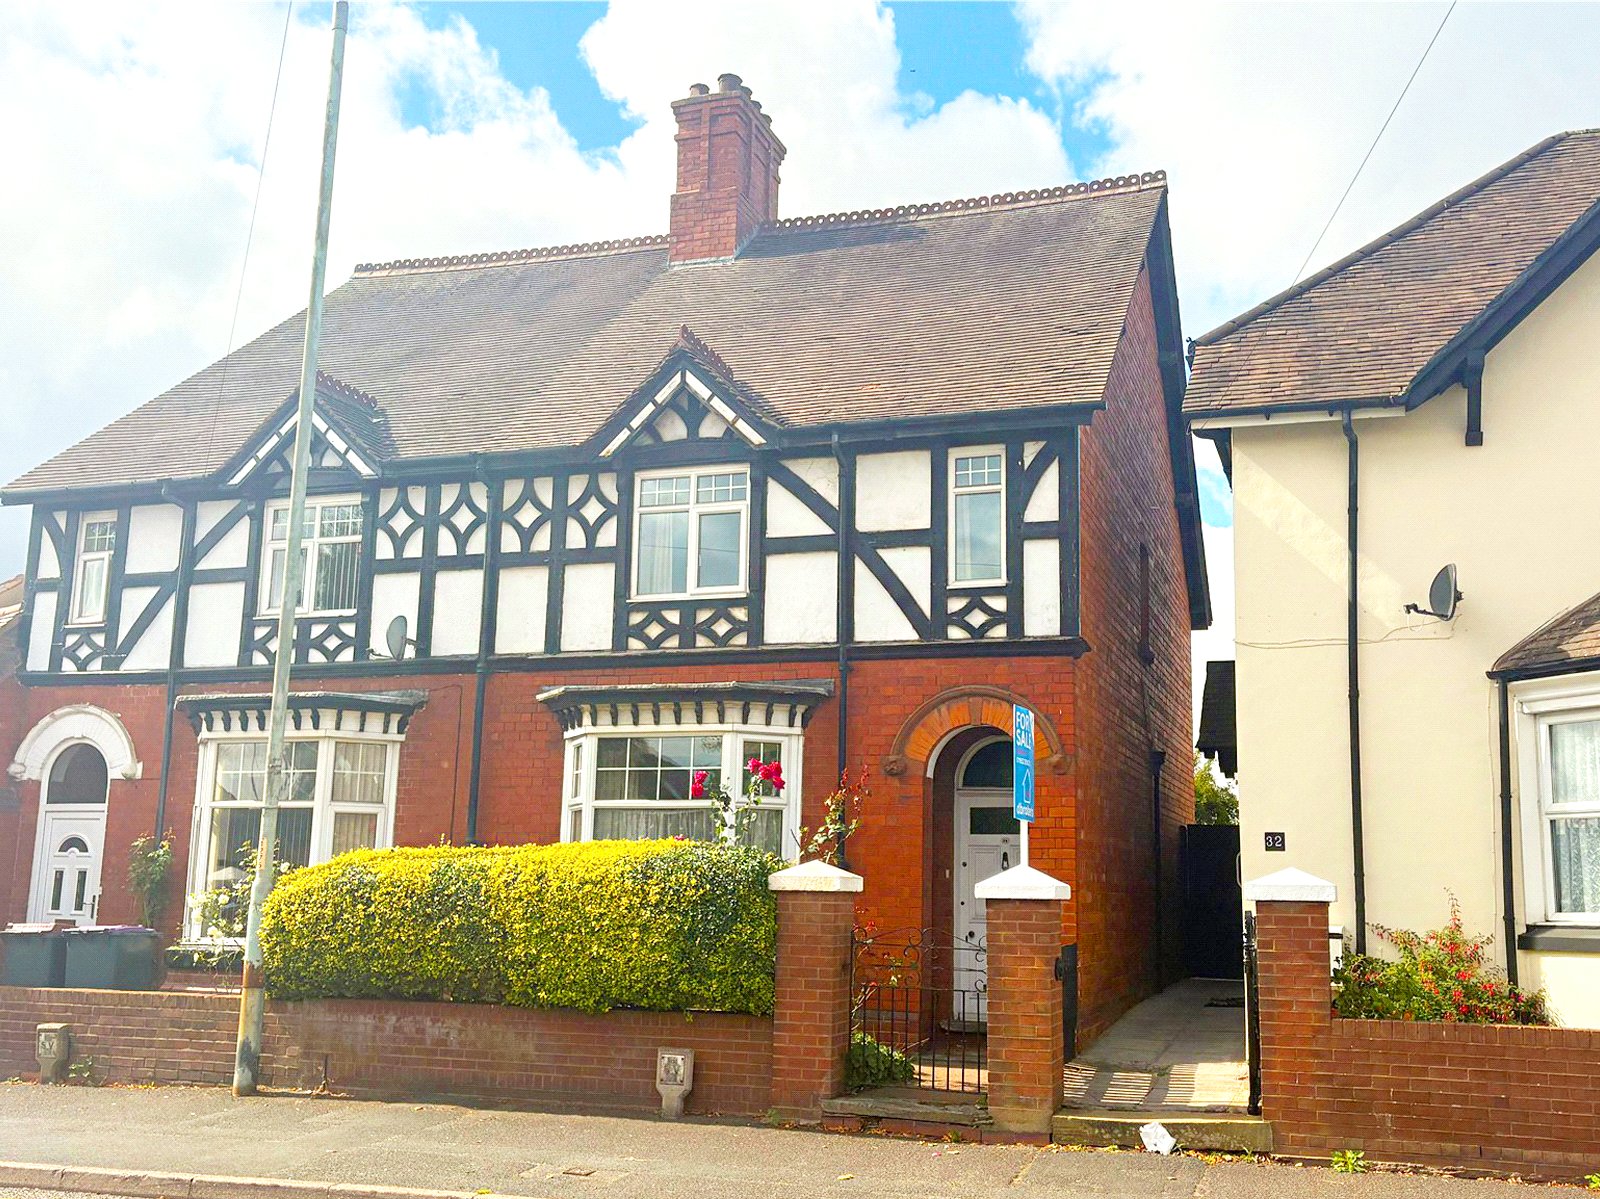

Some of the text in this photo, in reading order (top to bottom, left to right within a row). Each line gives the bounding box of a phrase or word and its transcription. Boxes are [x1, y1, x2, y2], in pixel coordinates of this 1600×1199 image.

[1016, 711, 1030, 731] FOR
[1016, 729, 1031, 750] SALE
[1266, 835, 1282, 847] 32
